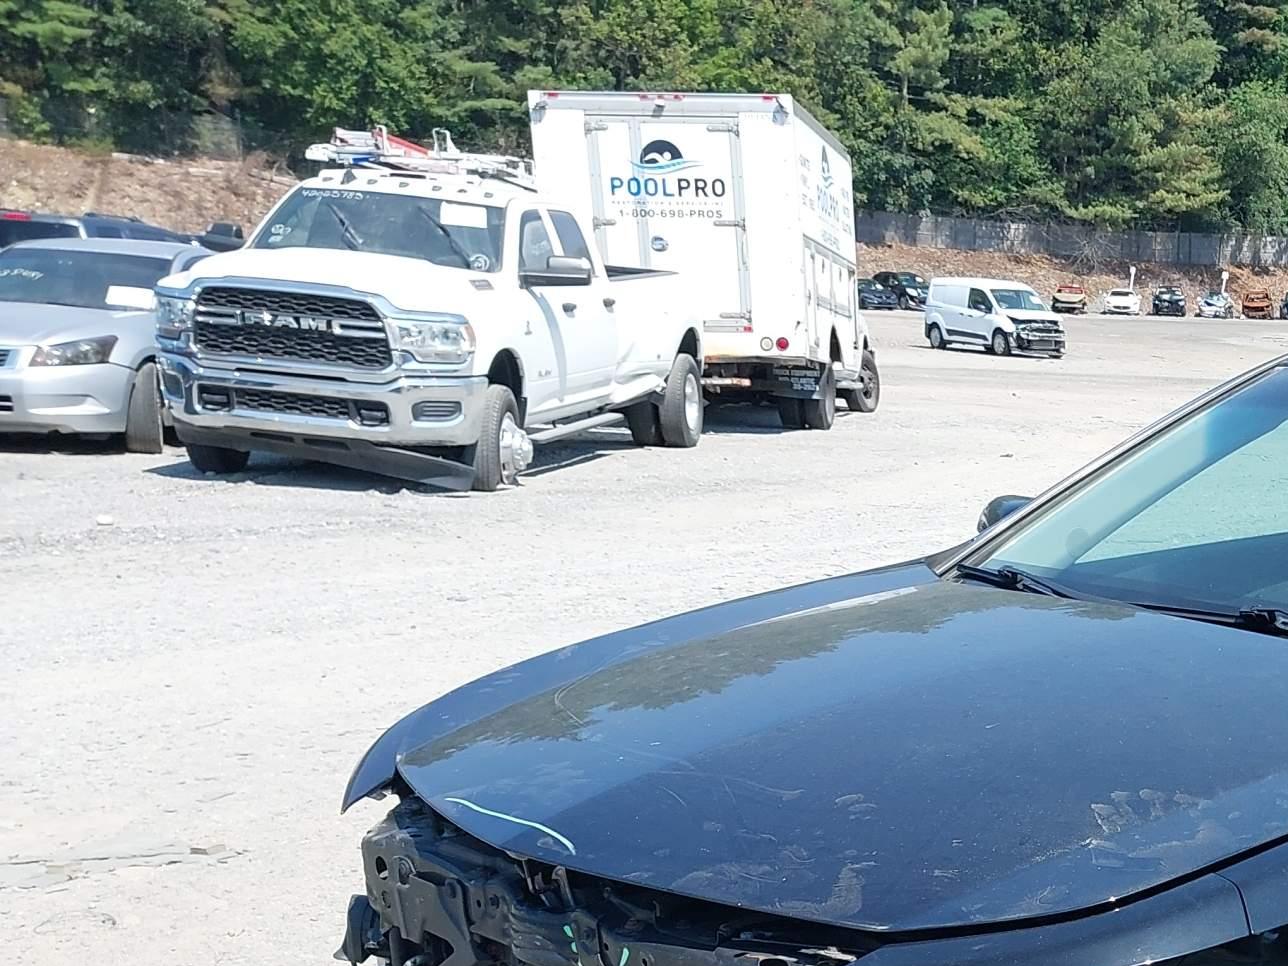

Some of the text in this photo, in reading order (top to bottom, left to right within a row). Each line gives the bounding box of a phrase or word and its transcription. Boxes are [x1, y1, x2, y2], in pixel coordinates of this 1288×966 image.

[610, 177, 726, 197] POOLPRO
[620, 208, 723, 219] 1-800-698-PROS
[243, 310, 328, 332] RAM
